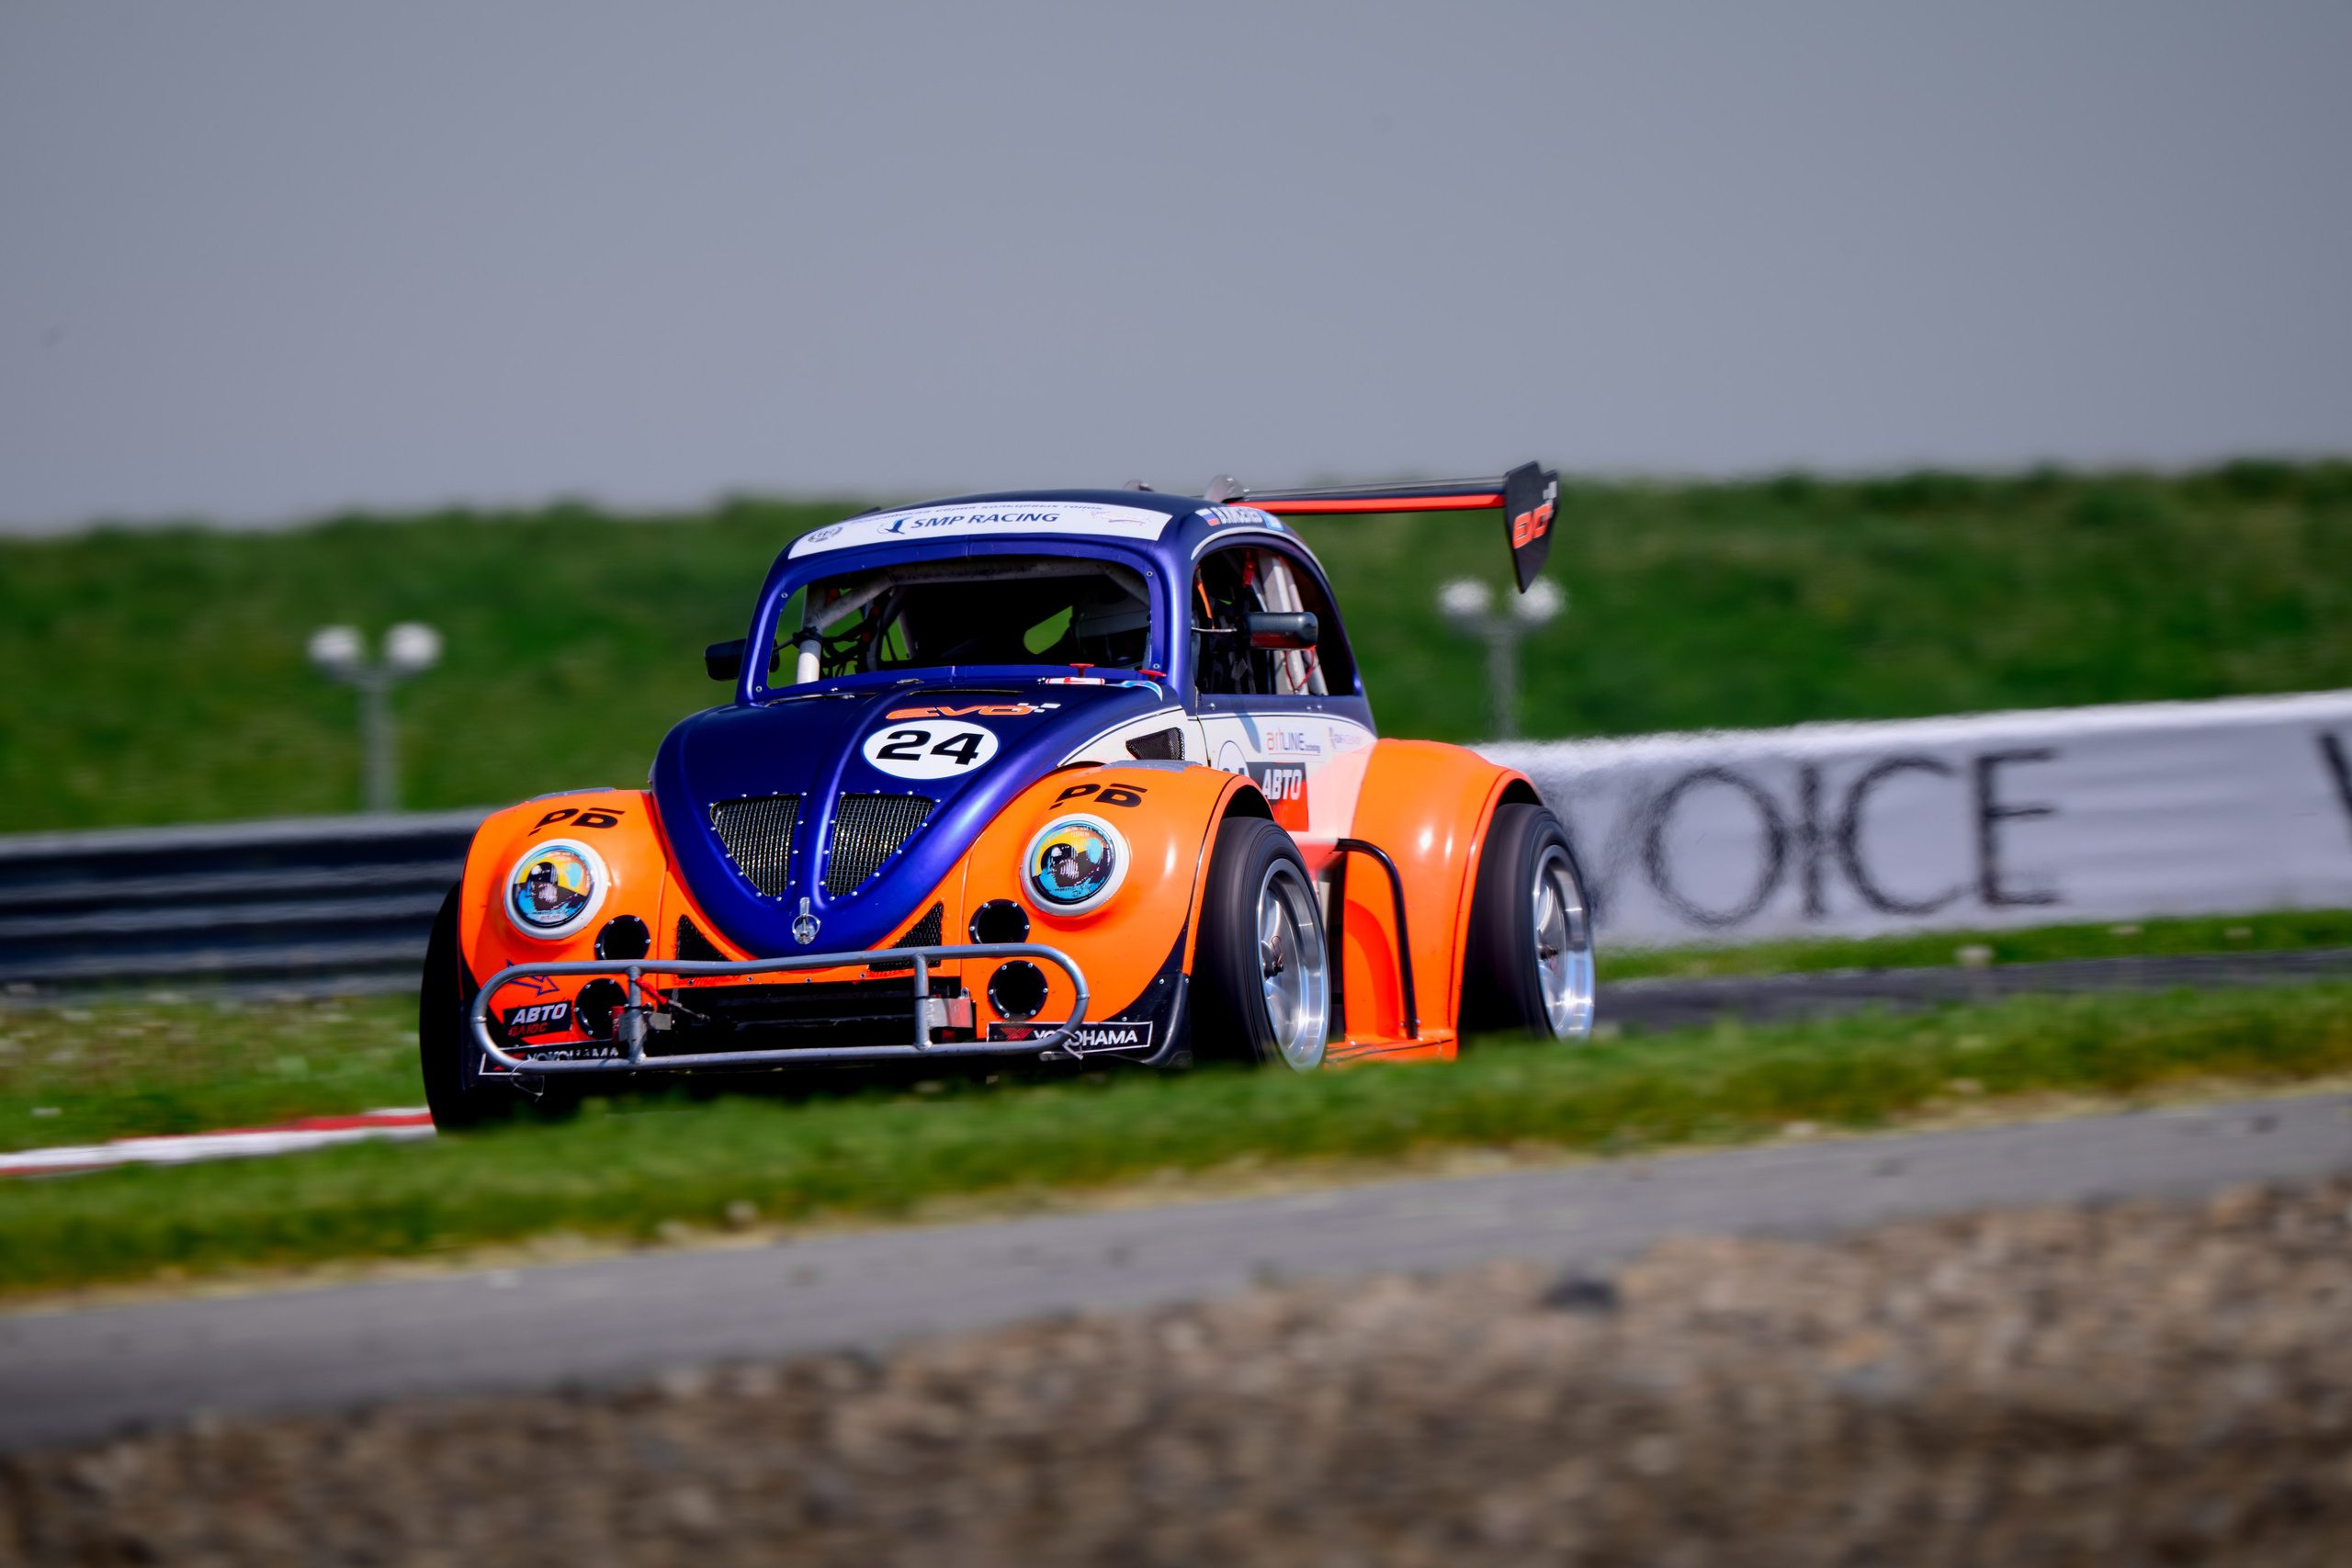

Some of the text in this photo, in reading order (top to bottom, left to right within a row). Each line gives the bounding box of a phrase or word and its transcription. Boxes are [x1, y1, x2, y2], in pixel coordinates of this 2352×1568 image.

[910, 513, 1061, 529] SMP RACING
[886, 705, 1035, 719] EVO
[876, 730, 984, 765] 24
[511, 1003, 569, 1025] АВТО
[1033, 1030, 1138, 1046] YOOHAMA
